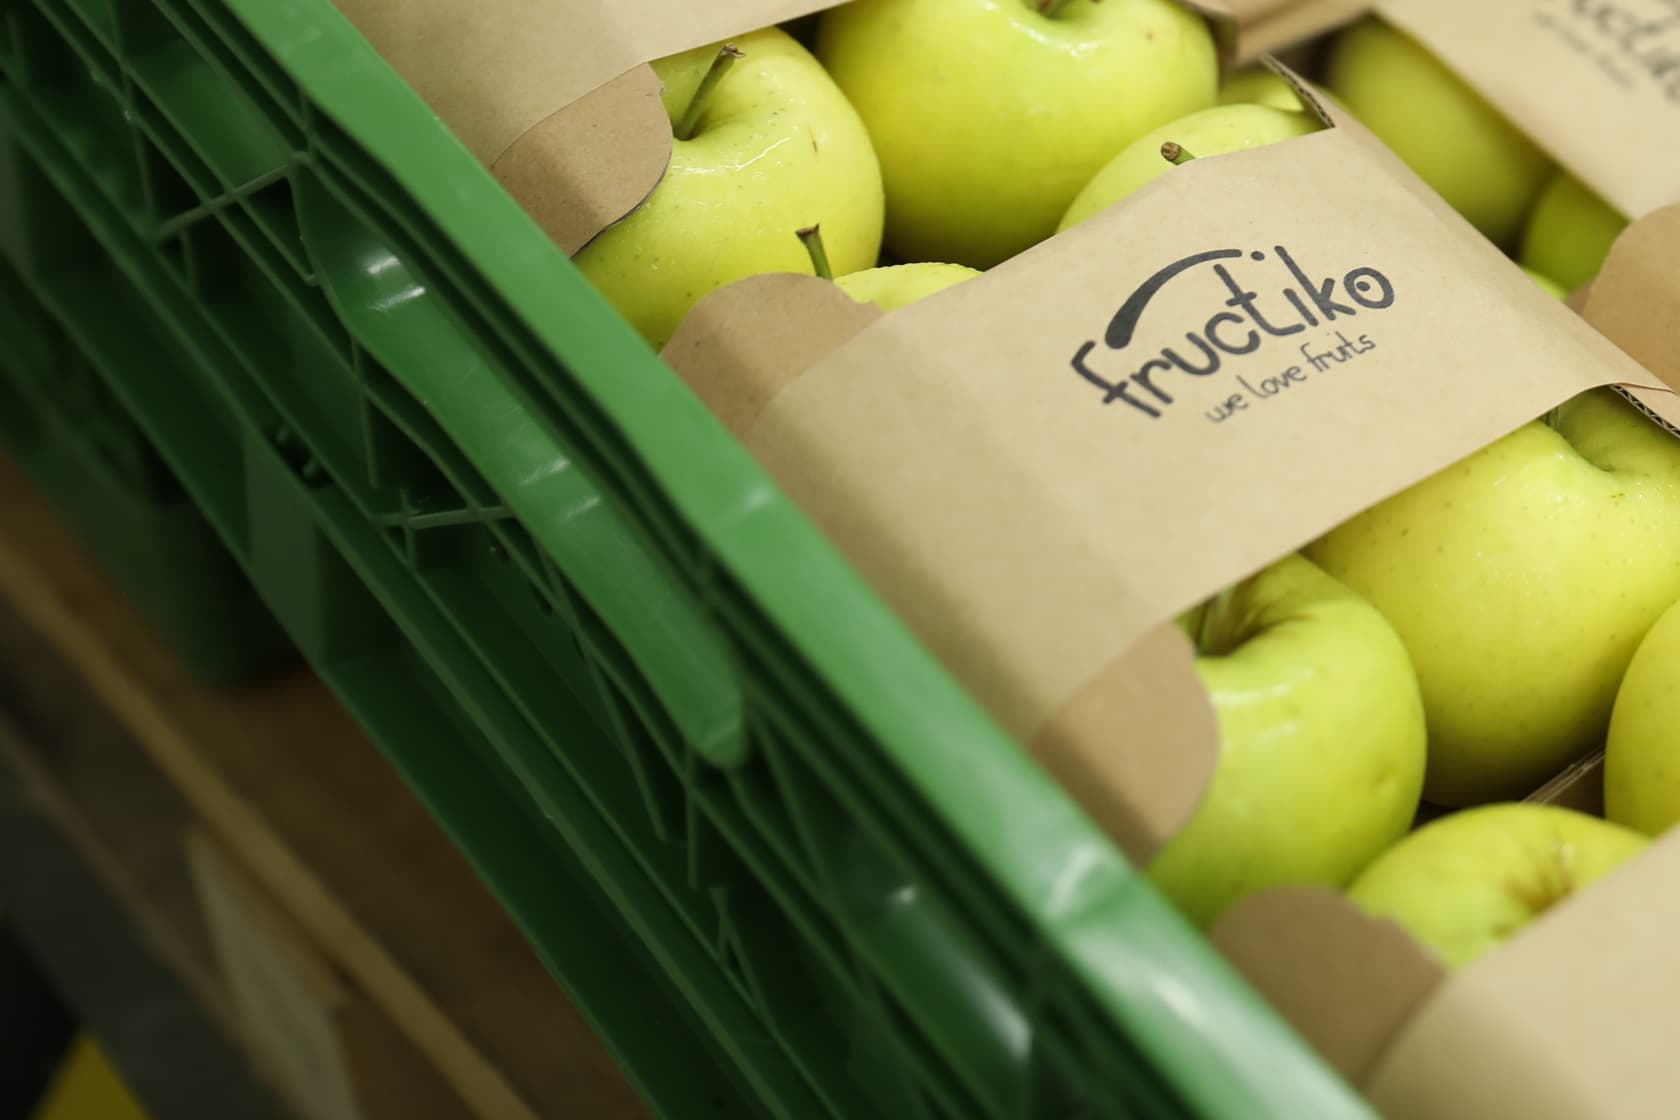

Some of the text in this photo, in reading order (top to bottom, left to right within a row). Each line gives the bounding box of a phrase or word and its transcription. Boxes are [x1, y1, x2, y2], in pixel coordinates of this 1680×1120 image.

[1071, 245, 1395, 418] fructiko
[1204, 331, 1378, 424] we love fruits
